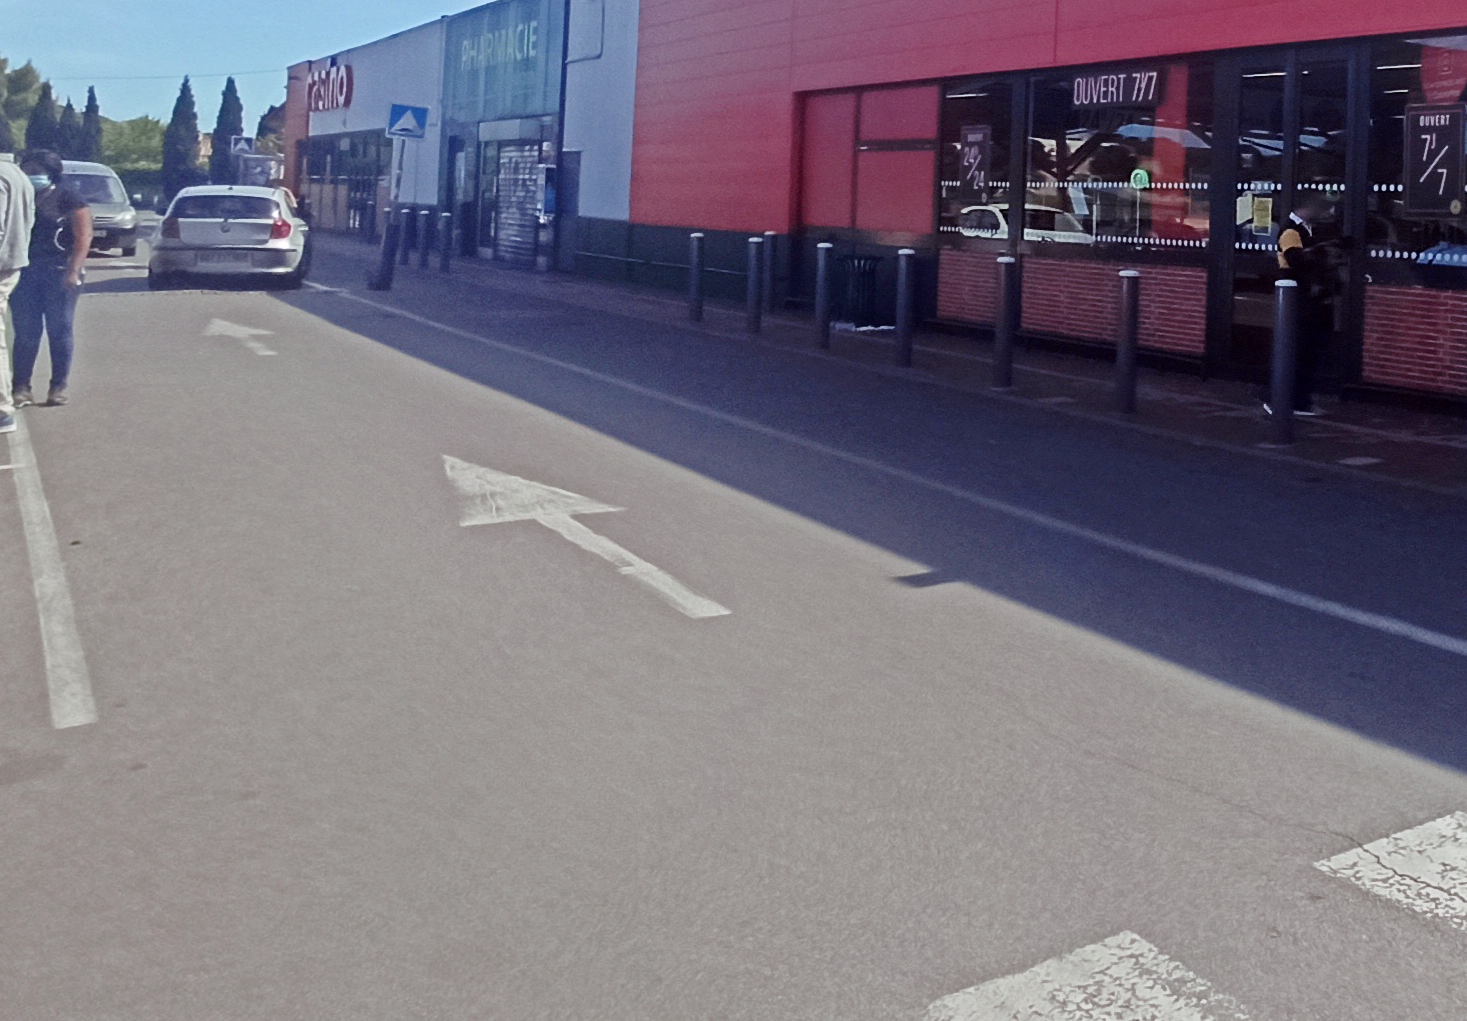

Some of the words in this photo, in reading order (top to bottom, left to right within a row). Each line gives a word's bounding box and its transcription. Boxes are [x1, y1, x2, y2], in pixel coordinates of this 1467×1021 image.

[461, 20, 538, 72] PHARMACIE
[1073, 74, 1127, 105] OUVERT
[1419, 114, 1450, 127] OUVERT
